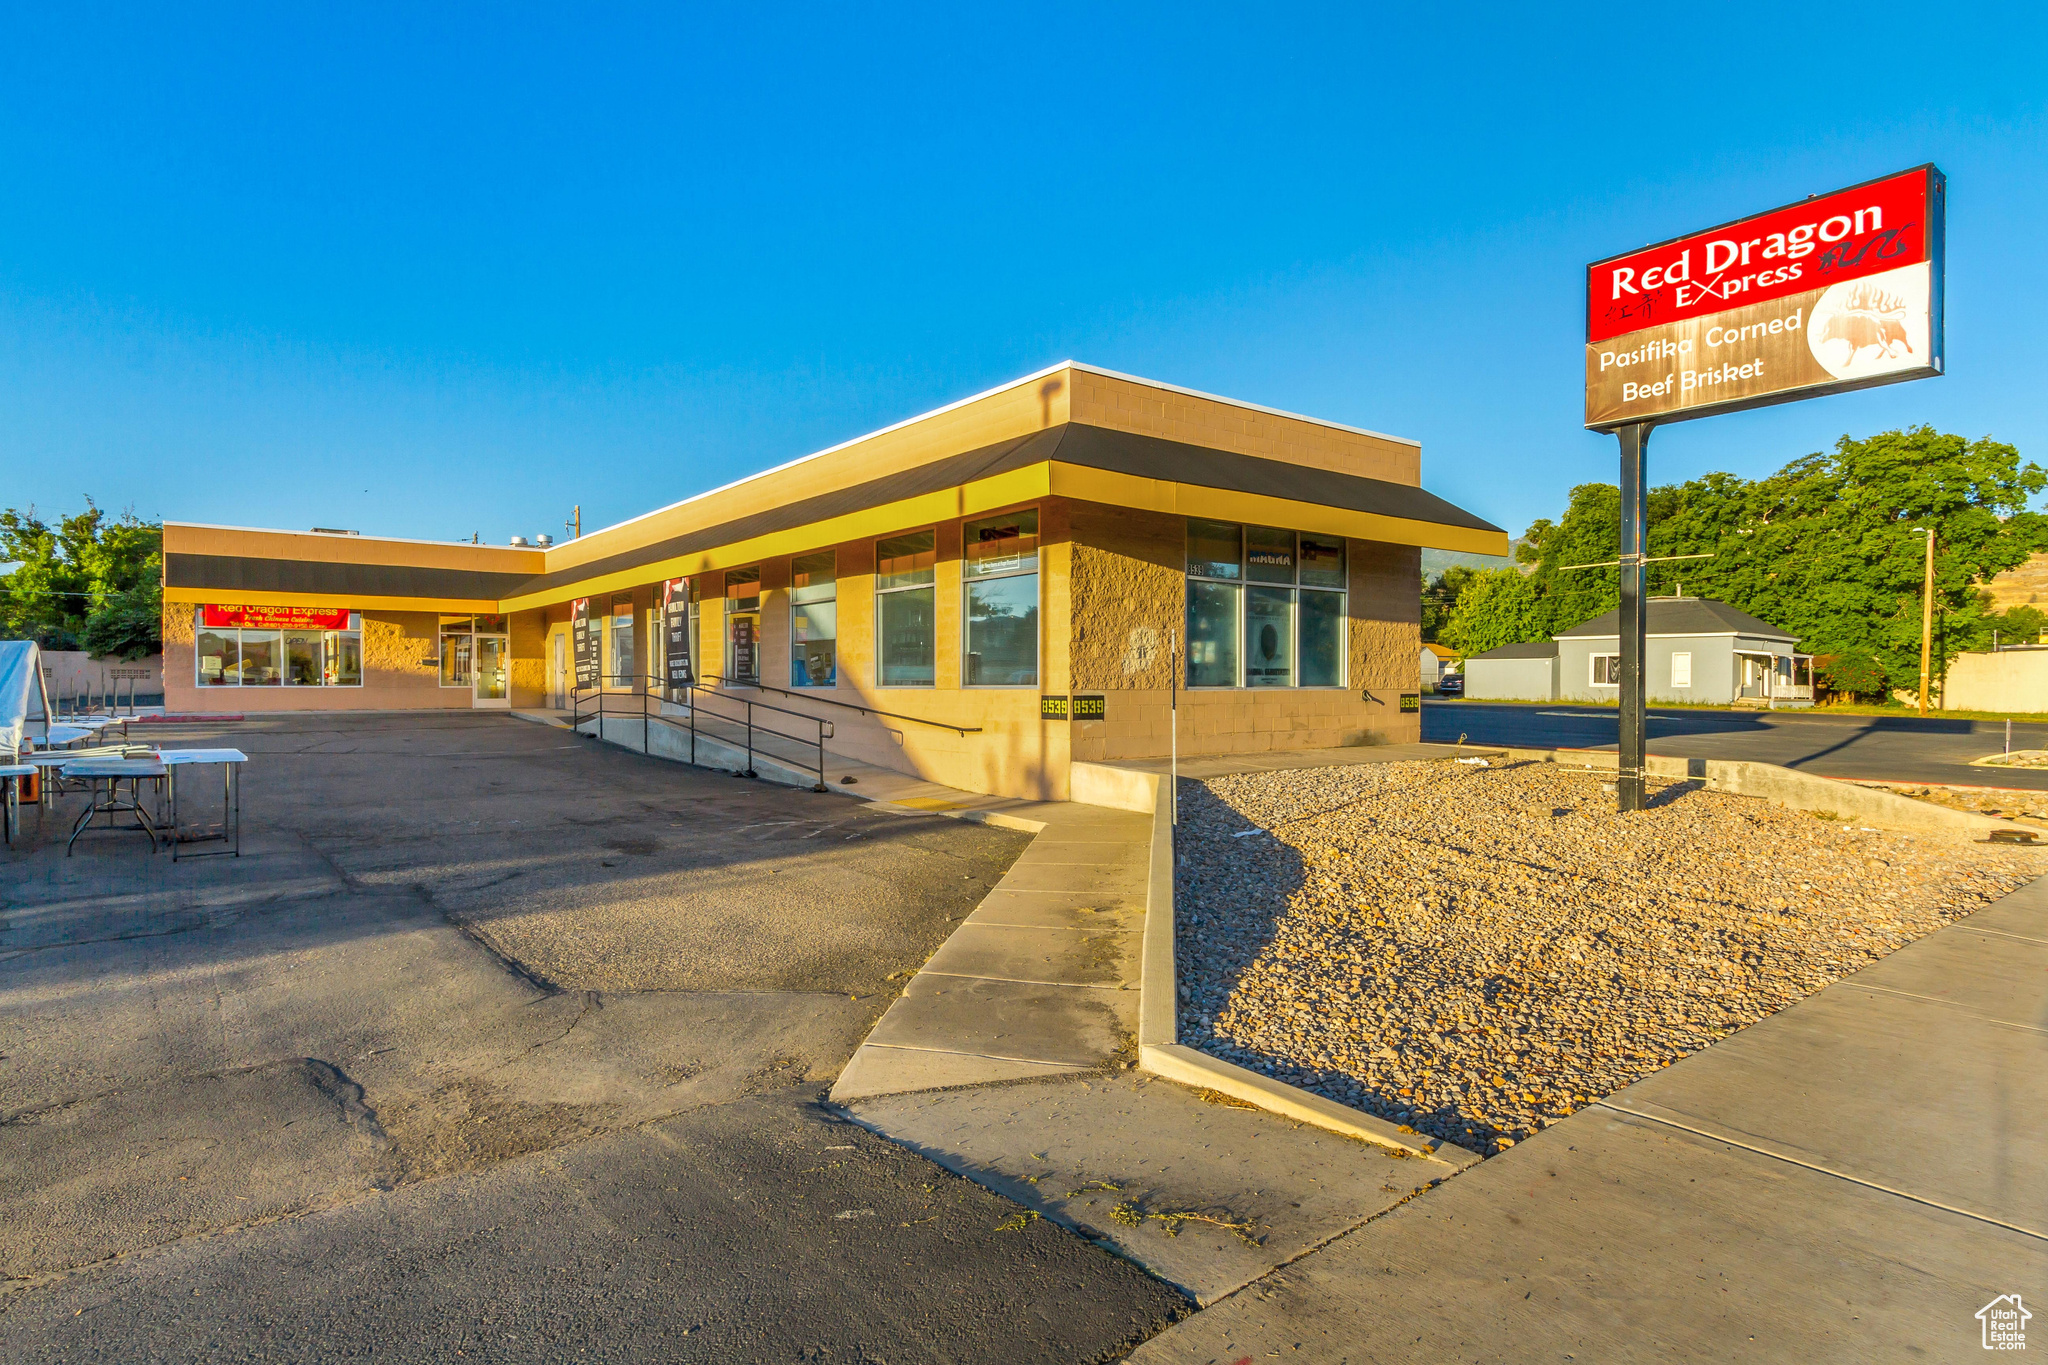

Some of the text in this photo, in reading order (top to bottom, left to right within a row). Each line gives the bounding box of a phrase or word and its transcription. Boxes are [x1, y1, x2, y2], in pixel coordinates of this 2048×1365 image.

[1612, 205, 1883, 300] Red Dragon
[1600, 308, 1802, 372] Pasifika Corned
[1622, 358, 1764, 402] Beef Brisket
[218, 604, 338, 617] Red Dragon Express
[1042, 699, 1068, 714] 8539
[1073, 699, 1104, 714] 8539
[1400, 697, 1419, 708] 8539
